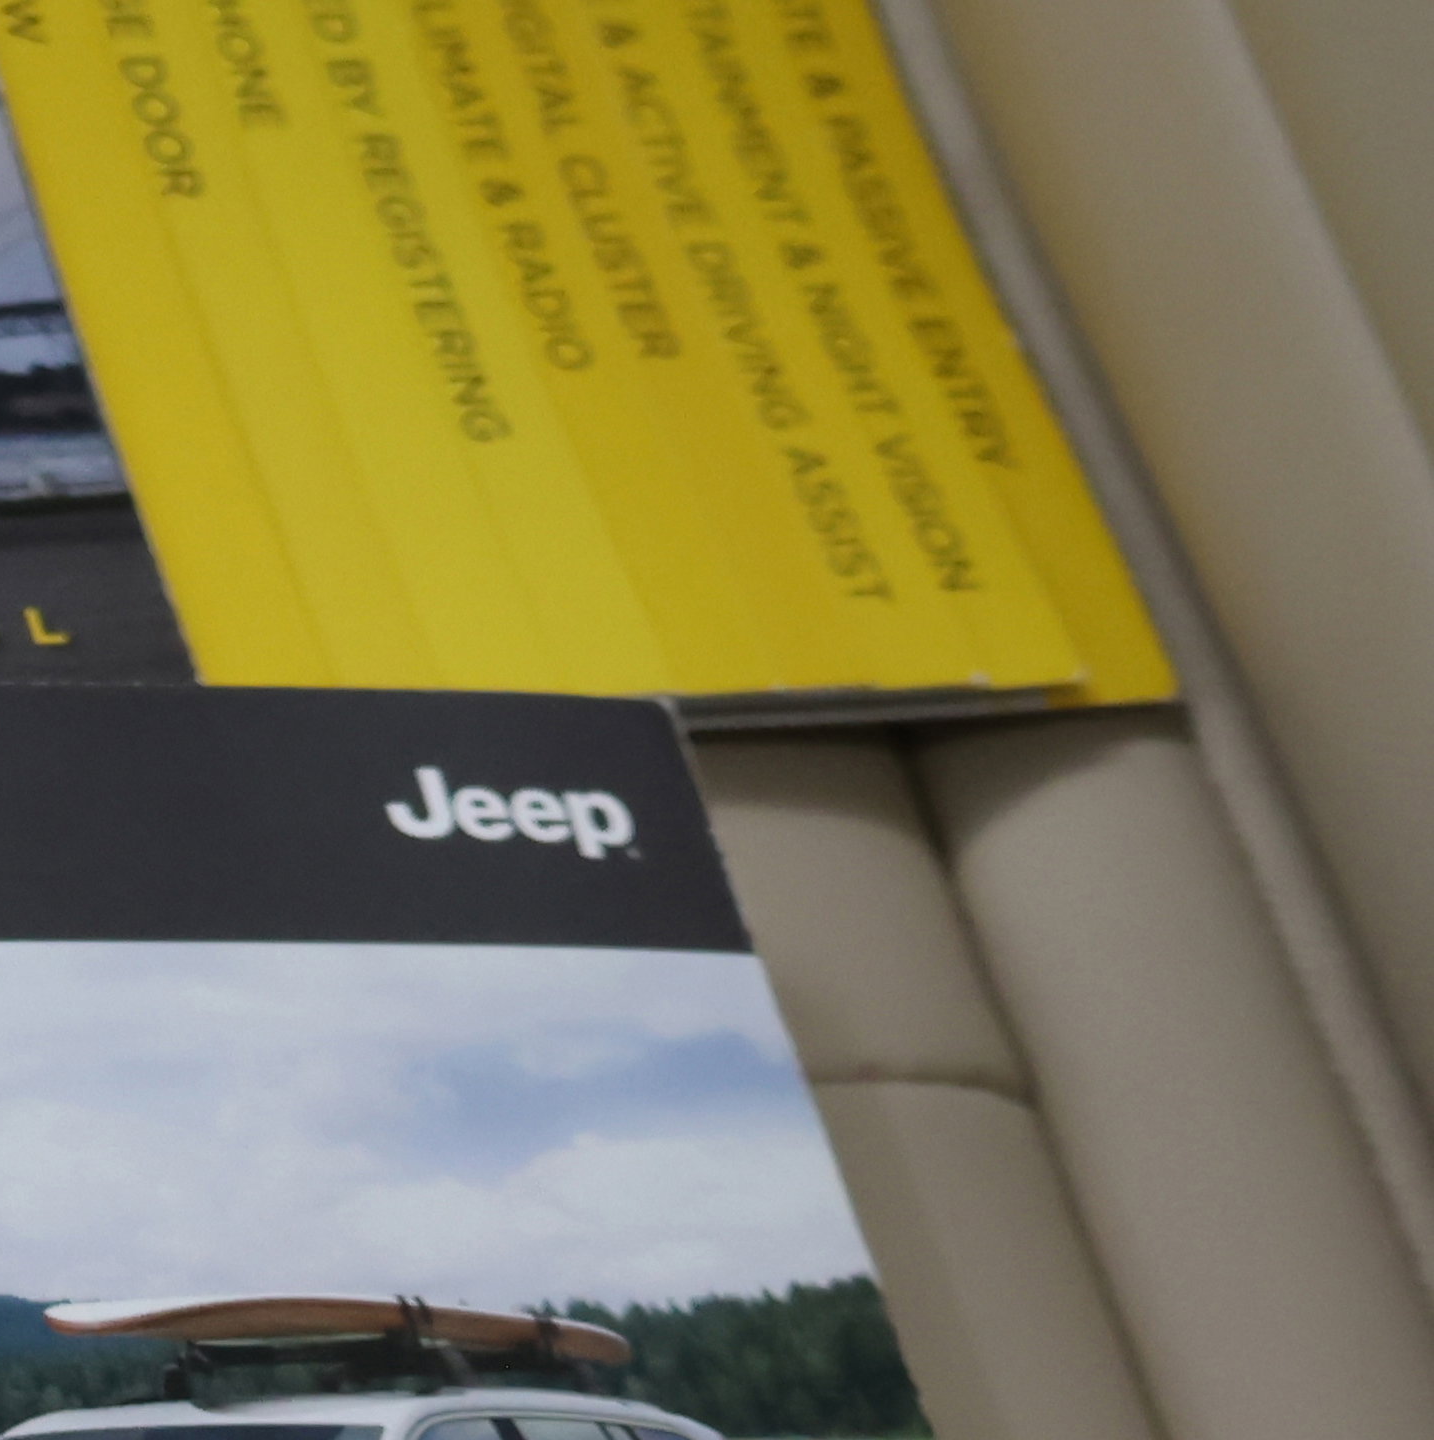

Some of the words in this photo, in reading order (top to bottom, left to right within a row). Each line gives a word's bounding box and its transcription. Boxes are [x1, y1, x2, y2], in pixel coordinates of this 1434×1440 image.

[118, 56, 204, 198] DOOR
[478, 179, 525, 206] &
[326, 58, 382, 117] BY
[354, 133, 513, 444] REGISTERING
[500, 224, 593, 371] RADIO
[558, 155, 681, 360] CLUSTER
[618, 66, 713, 225] ACTIVE
[685, 244, 811, 430] DRIVING
[780, 447, 894, 603] ASSIST
[907, 317, 1018, 469] ENTRY
[804, 284, 899, 415] NIGHT
[872, 434, 982, 593] VISION
[23, 606, 71, 646] L
[383, 764, 637, 861] Jeep
